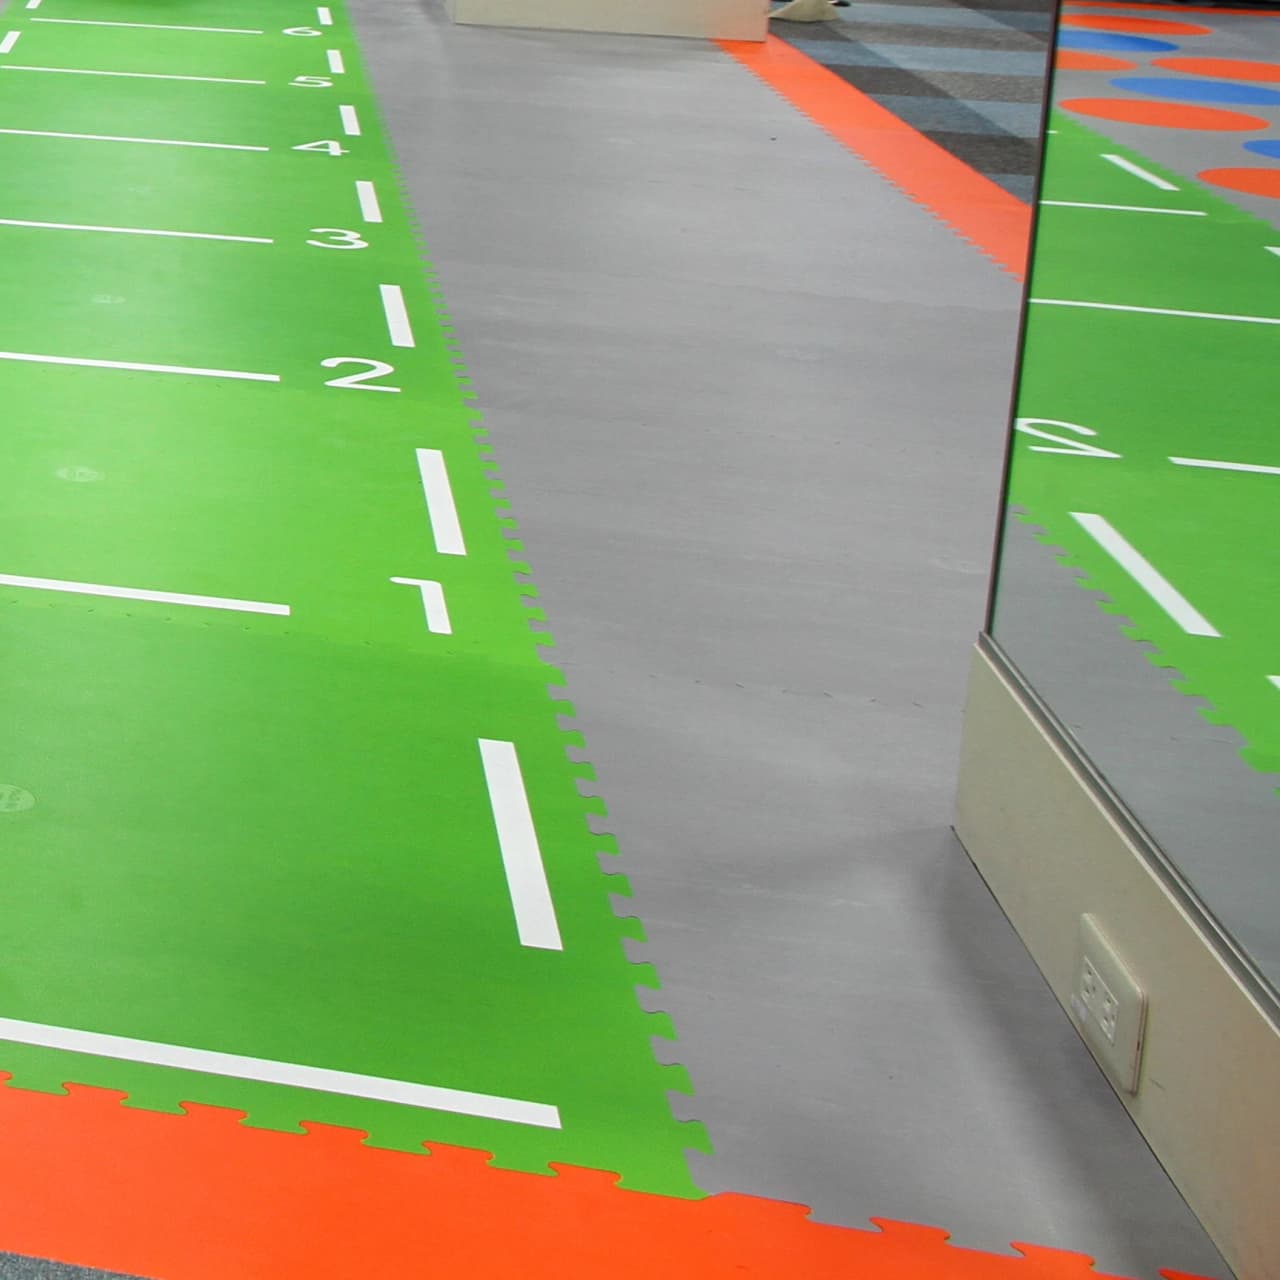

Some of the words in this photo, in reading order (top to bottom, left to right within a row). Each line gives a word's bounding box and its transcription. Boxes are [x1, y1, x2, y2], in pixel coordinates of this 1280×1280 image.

[281, 26, 323, 37] 6
[288, 75, 333, 88] 5
[291, 140, 350, 156] 4
[305, 228, 369, 250] 3
[320, 356, 402, 393] 2
[389, 576, 453, 635] 1
